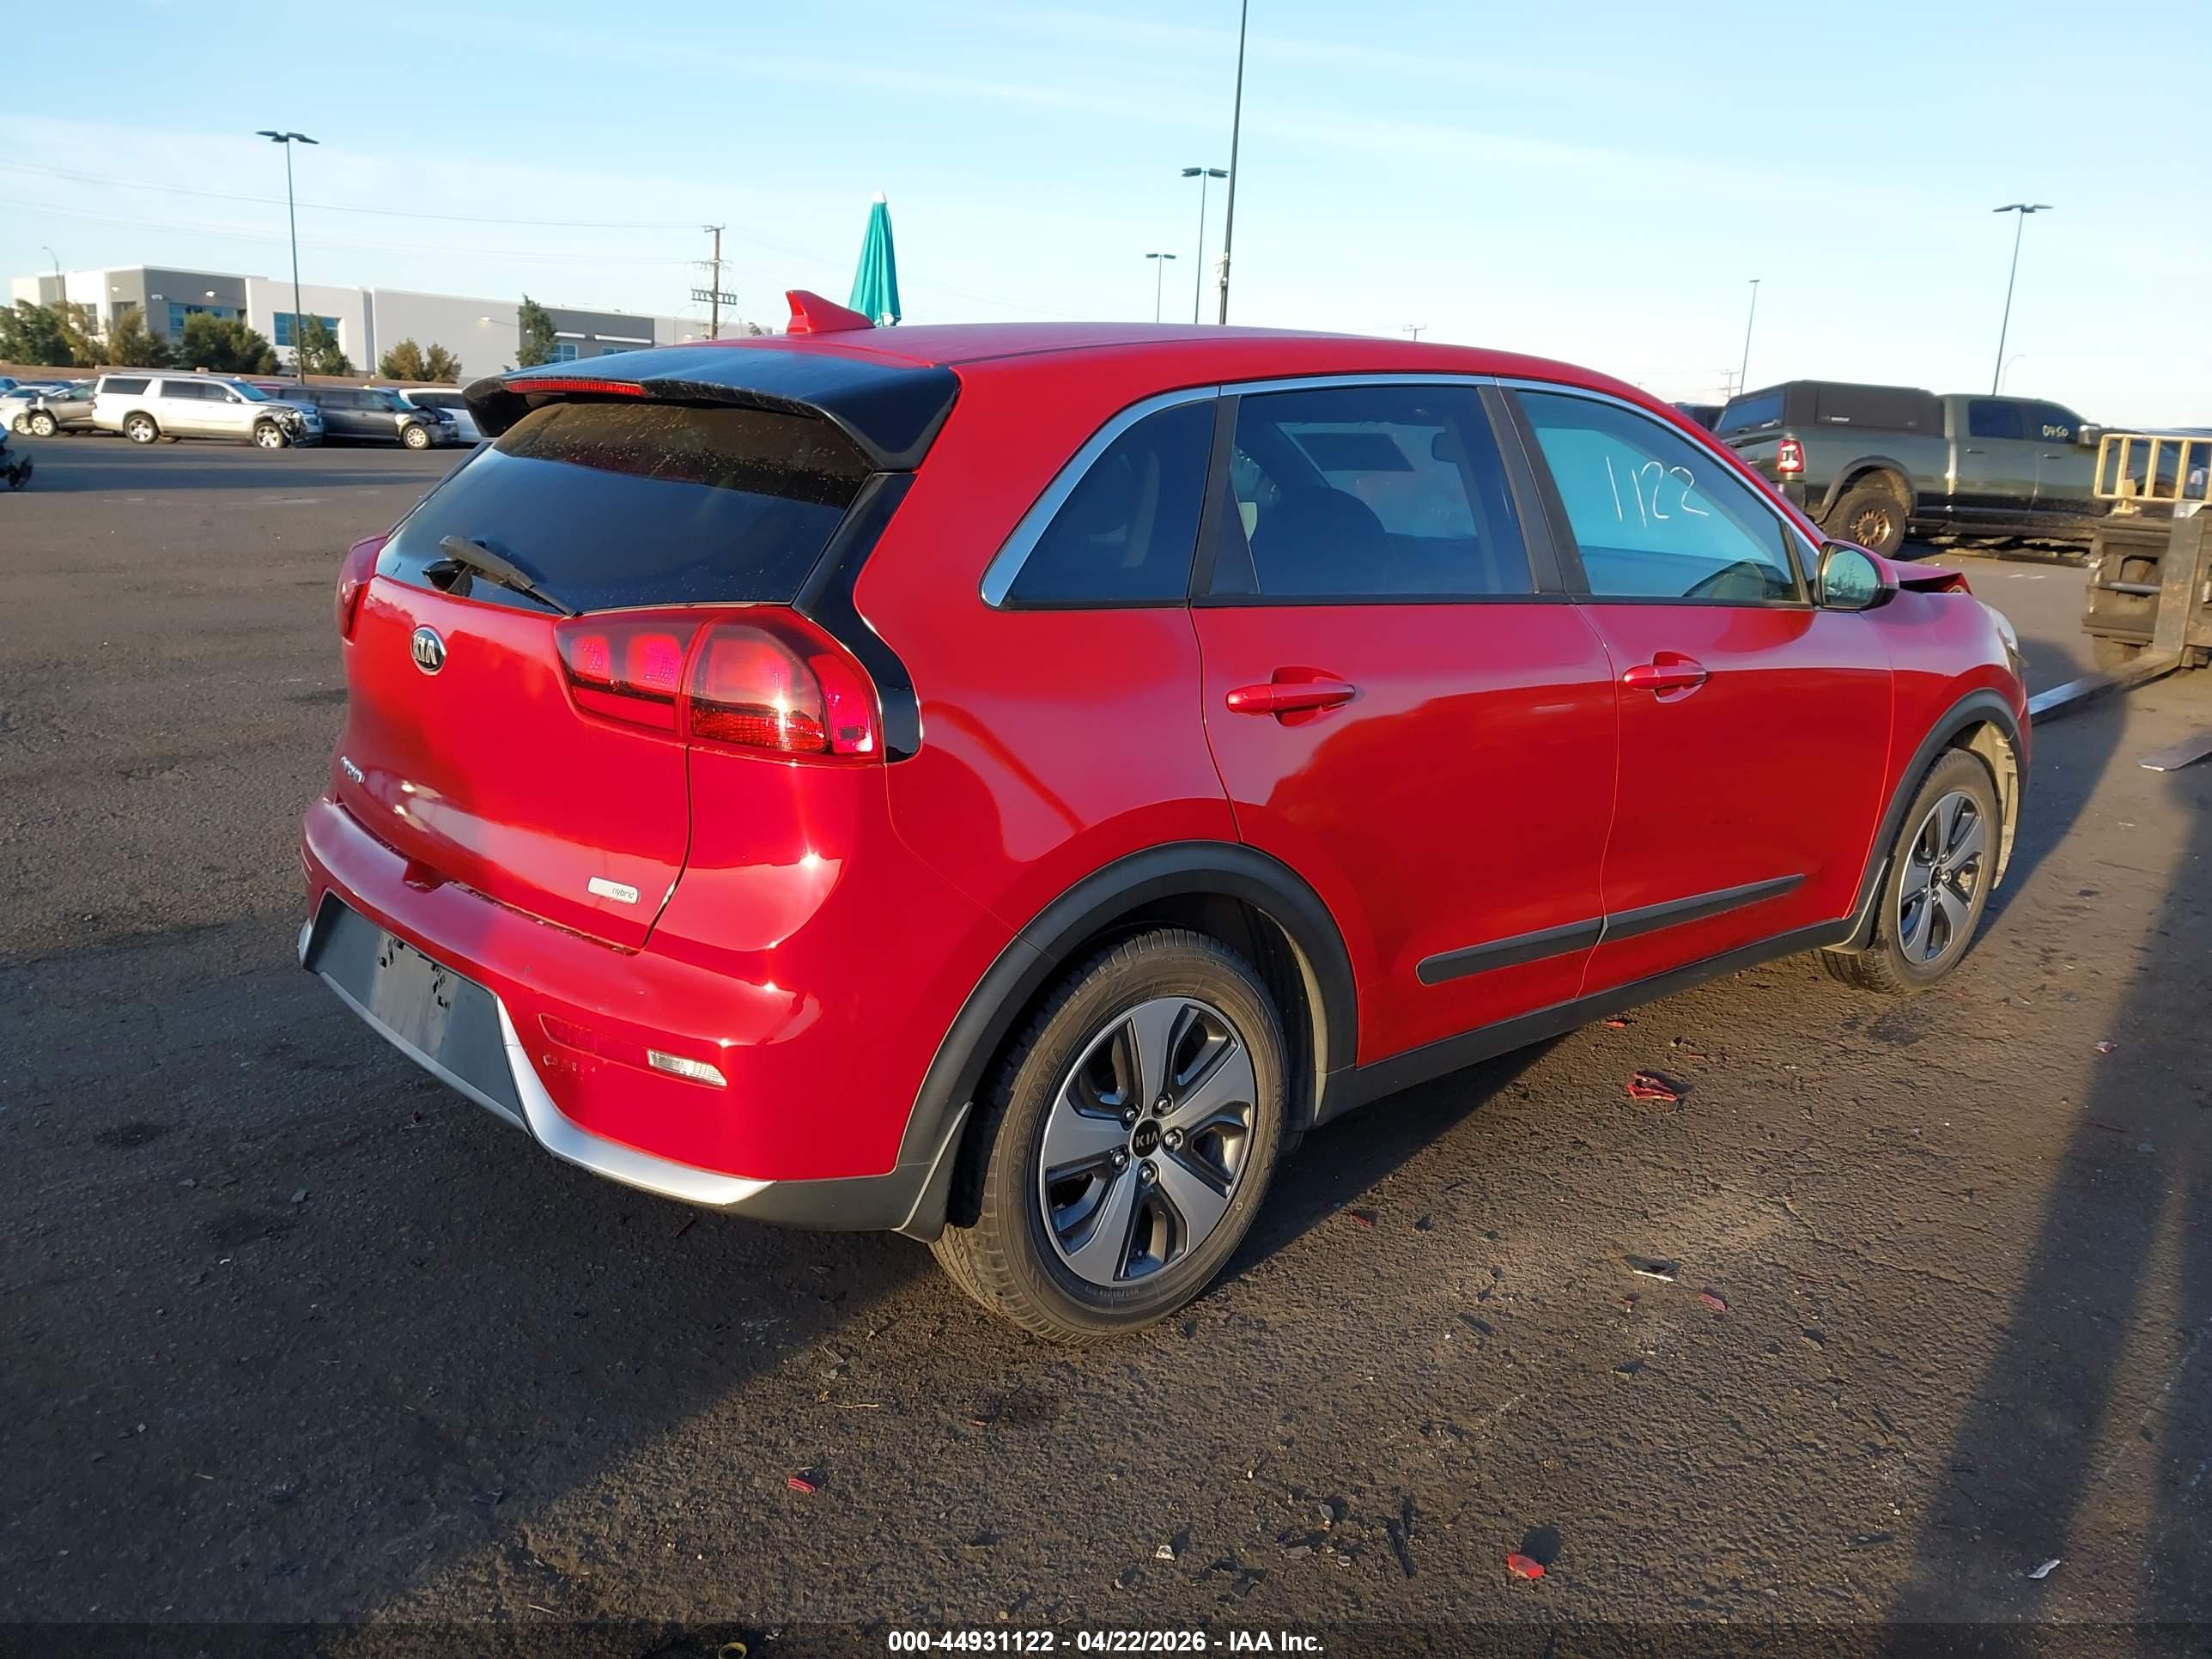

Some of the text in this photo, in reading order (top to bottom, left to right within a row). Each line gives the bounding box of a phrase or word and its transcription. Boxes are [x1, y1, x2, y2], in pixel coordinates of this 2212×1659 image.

[1605, 455, 1710, 529] 1122
[413, 635, 437, 665] KIA
[1135, 1131, 1158, 1148] KIA
